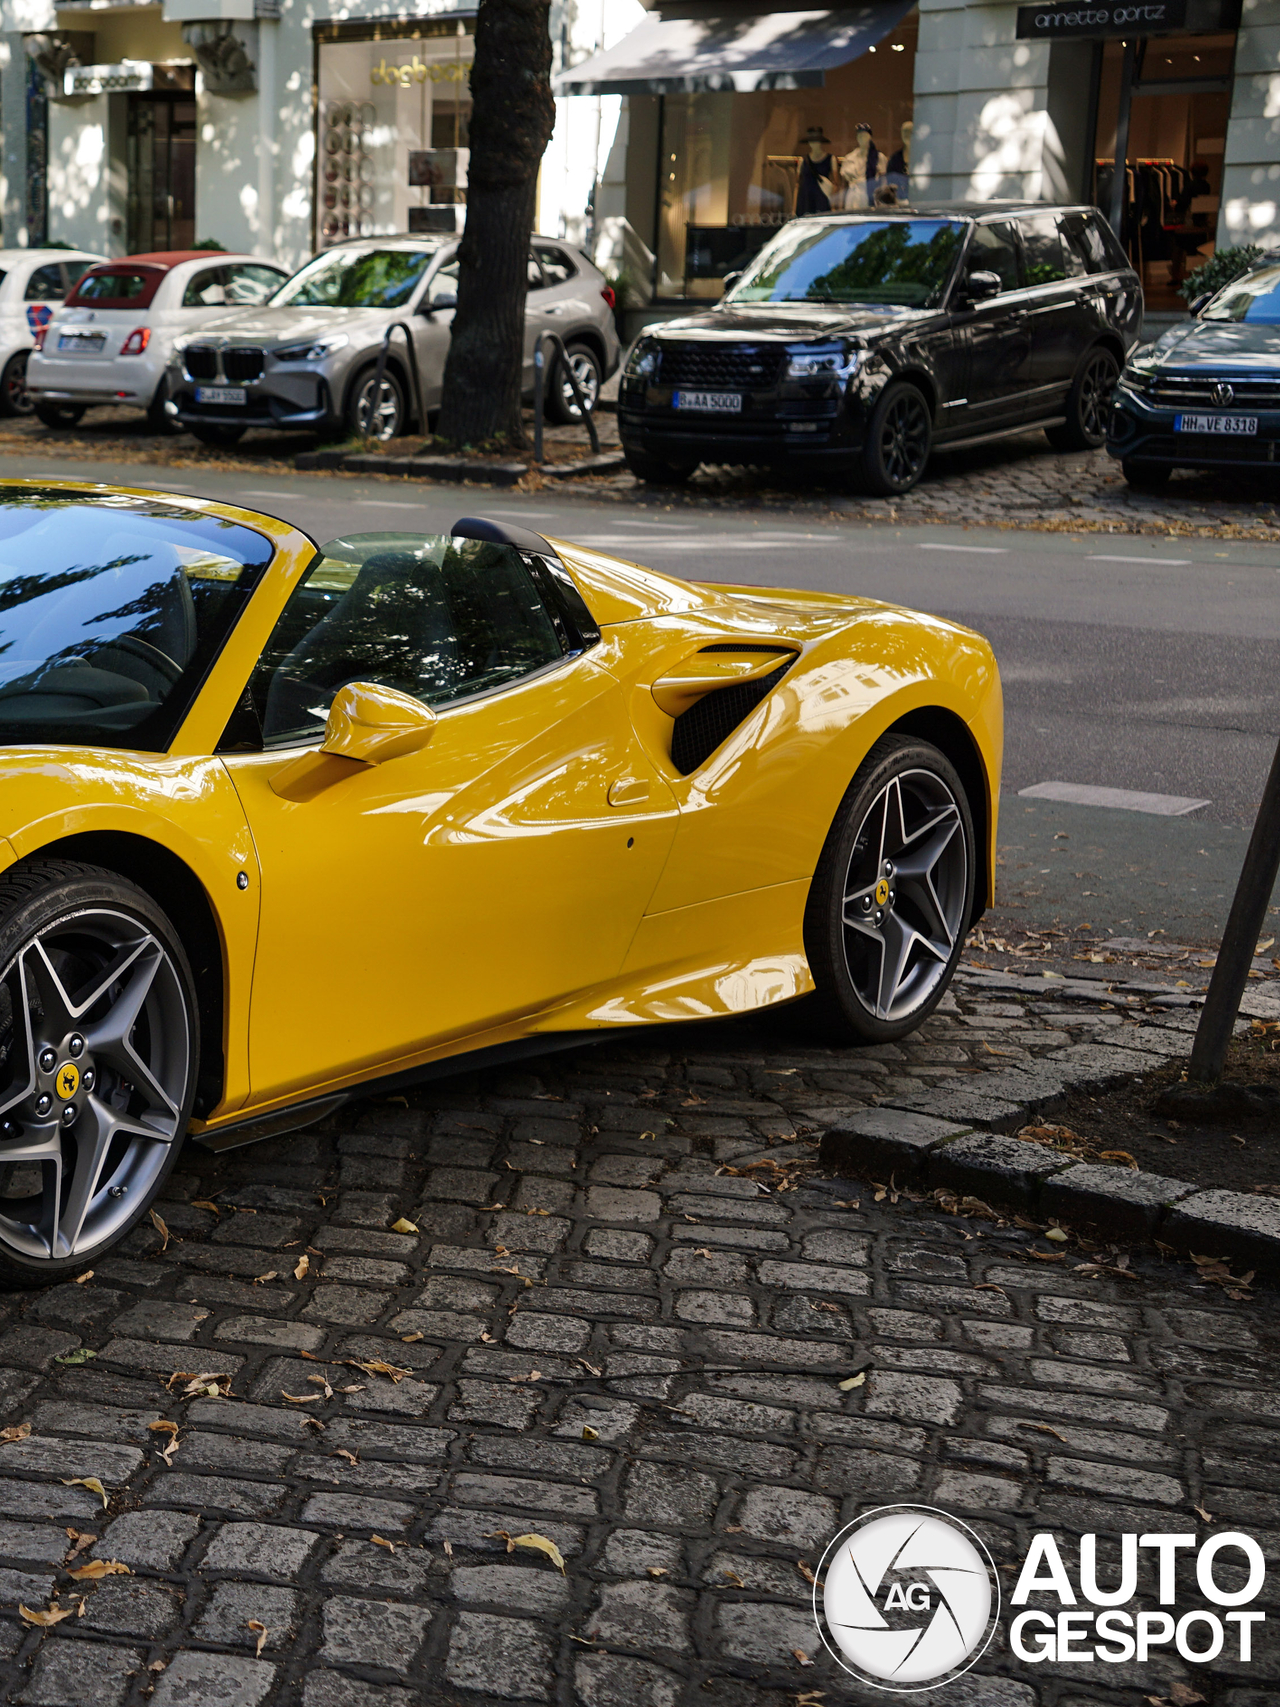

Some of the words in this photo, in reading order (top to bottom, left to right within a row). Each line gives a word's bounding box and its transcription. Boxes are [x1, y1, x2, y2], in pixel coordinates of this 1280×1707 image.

[1034, 9, 1109, 28] annette
[1113, 5, 1166, 25] görtz
[695, 394, 709, 407] AA
[711, 394, 740, 408] 5000
[1182, 416, 1198, 431] HH
[1206, 417, 1222, 431] VE
[1224, 418, 1256, 433] 8318
